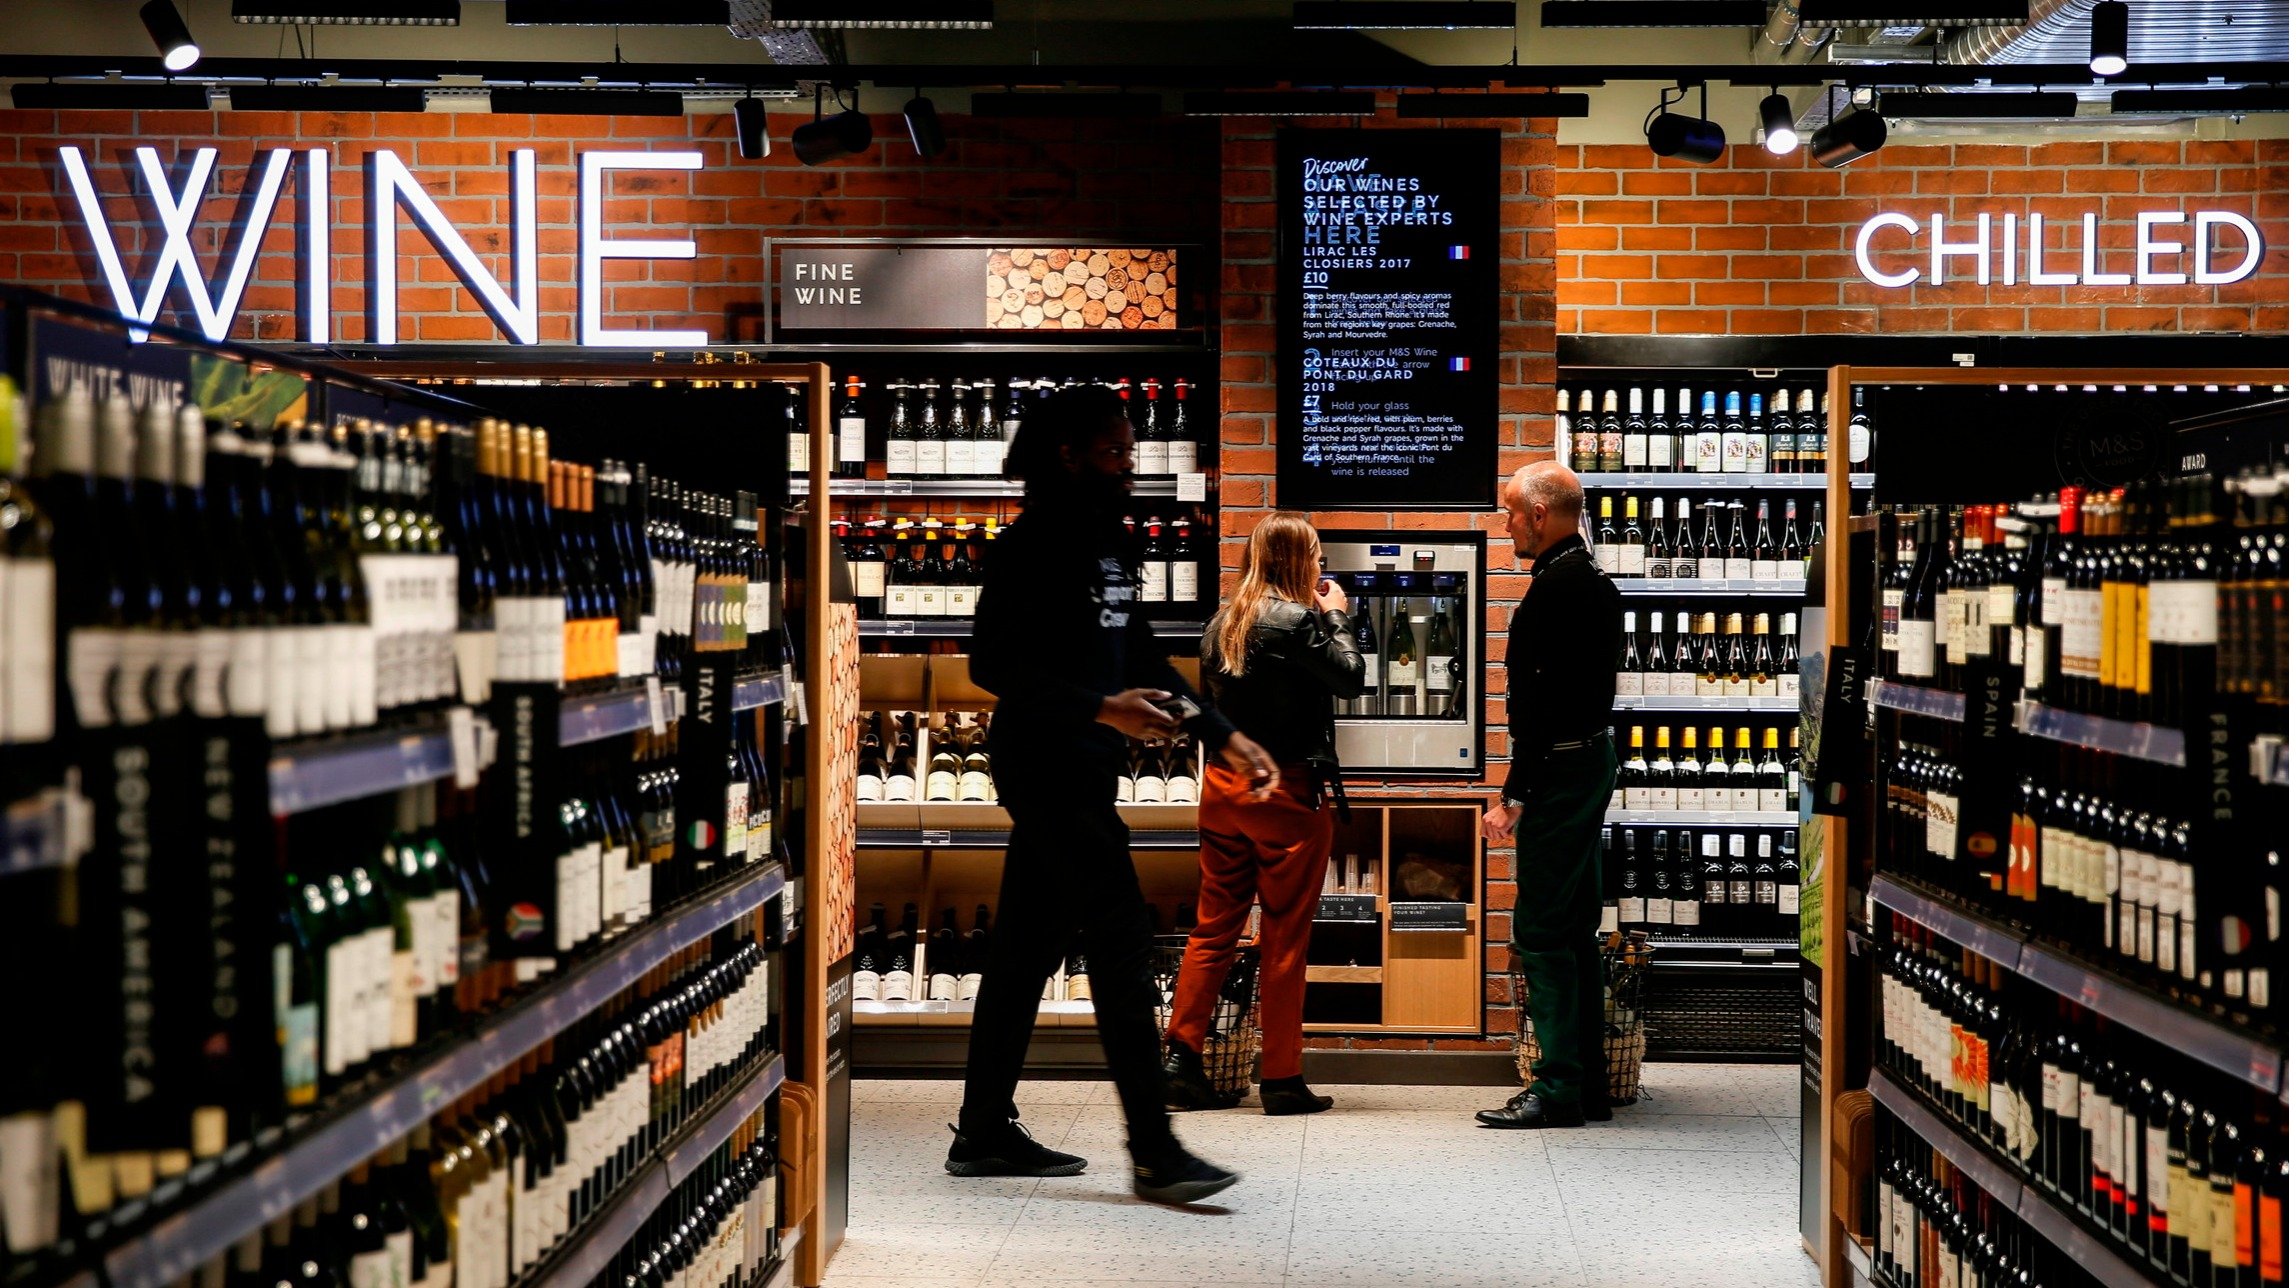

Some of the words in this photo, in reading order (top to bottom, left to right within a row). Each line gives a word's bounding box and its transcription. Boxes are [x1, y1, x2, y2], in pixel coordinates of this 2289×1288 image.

[1303, 157, 1369, 178] Discover
[1303, 178, 1346, 192] OUR
[1356, 178, 1420, 192] WINES
[1303, 195, 1406, 208] SELECTED
[1414, 195, 1440, 208] BY
[1303, 212, 1355, 226] WINE
[1364, 212, 1453, 226] EXPERTS
[1304, 226, 1381, 244] HERE
[59, 146, 708, 346] WINE
[1303, 246, 1346, 256] LIRAC
[1352, 246, 1377, 256] LES
[1855, 210, 2266, 288] CHILLED
[1303, 259, 1374, 268] CLOSIERS
[1379, 259, 1411, 268] 2017
[795, 264, 854, 281] FINE
[1303, 272, 1329, 284] £10
[795, 287, 863, 305] WINE
[1302, 292, 1324, 300] Deep
[1326, 292, 1348, 300] berry
[1401, 292, 1421, 300] spicy
[1392, 301, 1434, 309] full-bodied
[1324, 312, 1346, 320] Lirac,
[1340, 321, 1370, 330] region's
[1372, 321, 1386, 330] key
[1418, 320, 1457, 328] Grenache,
[1302, 331, 1325, 340] Syrah
[1332, 348, 1359, 356] Insert
[1363, 350, 1386, 358] your
[1389, 348, 1410, 356] M&S
[1414, 348, 1438, 356] Wine
[1303, 358, 1370, 368] COTEAUX
[1376, 358, 1396, 368] DU
[1303, 370, 1342, 380] PONT
[1348, 370, 1367, 380] DU
[1373, 370, 1413, 380] GARD
[129, 372, 185, 411] WINE
[1303, 383, 1336, 392] 2018
[1303, 395, 1320, 407] £7
[1332, 401, 1355, 410] Hold
[1358, 404, 1380, 412] your
[1384, 401, 1410, 412] glass
[1402, 416, 1426, 424] plum,
[1360, 434, 1382, 443] Syrah
[1414, 436, 1439, 444] grown
[2089, 430, 2145, 458] M&S
[1322, 444, 1358, 453] vineyards
[1380, 444, 1394, 452] the
[1396, 443, 1419, 451] iconic
[1418, 455, 1436, 464] the
[2182, 453, 2206, 472] AWARD
[1332, 467, 1354, 476] wine
[1356, 467, 1365, 476] is
[1368, 467, 1410, 476] released
[1841, 659, 1856, 704] ITALY
[698, 668, 714, 724] ITALY
[1983, 676, 2000, 738] SPAIN
[514, 694, 534, 762] SOUTH
[2210, 713, 2232, 820] FRANCE
[204, 737, 236, 823] NEW
[514, 765, 534, 840] AFRICA
[113, 745, 152, 895] SOUTH
[206, 835, 240, 1020] ZEALAND
[1803, 977, 1818, 1006] WELL
[120, 904, 156, 1104] AMERICA
